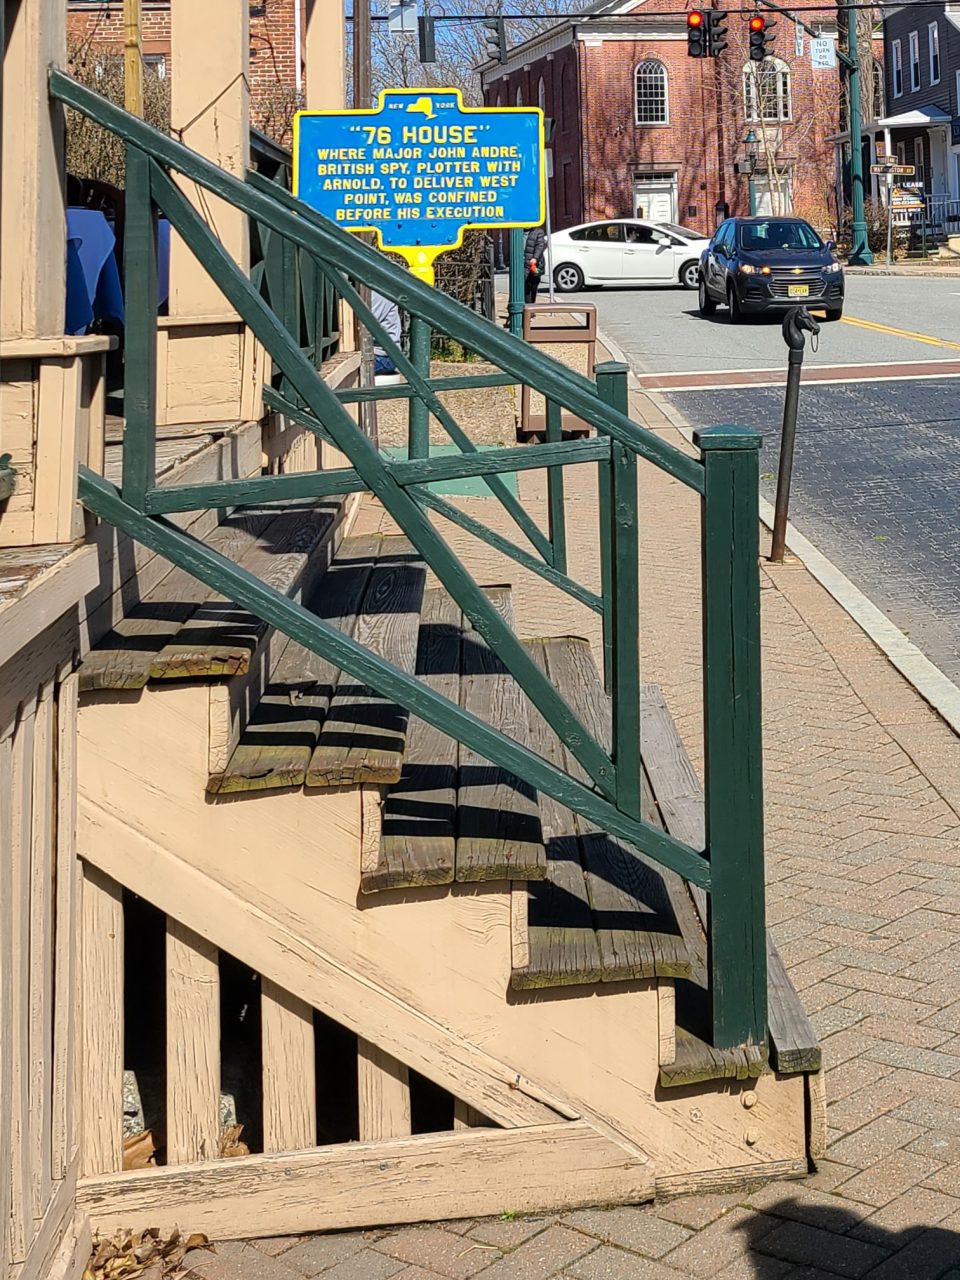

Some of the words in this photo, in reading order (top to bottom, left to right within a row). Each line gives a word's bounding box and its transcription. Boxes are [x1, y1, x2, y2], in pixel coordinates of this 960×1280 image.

[317, 148, 367, 161] WHERE
[372, 148, 422, 160] MAJOR
[428, 147, 466, 159] JOHN
[471, 147, 522, 159] ANDRE,
[317, 163, 374, 175] BRITISH
[380, 163, 411, 175] SPY,
[416, 162, 480, 174] PLOTTER
[486, 161, 521, 173] WITH
[323, 178, 385, 191] ARNOLD,
[390, 177, 407, 189] TO
[413, 177, 474, 189] DELIVER
[479, 176, 519, 188] WEST
[344, 193, 390, 205] POINT,
[394, 192, 422, 204] WAS
[428, 191, 497, 203] CONFINED
[335, 208, 392, 221] BEFORE
[397, 208, 421, 220] HIS
[425, 206, 504, 219] EXECUTION
